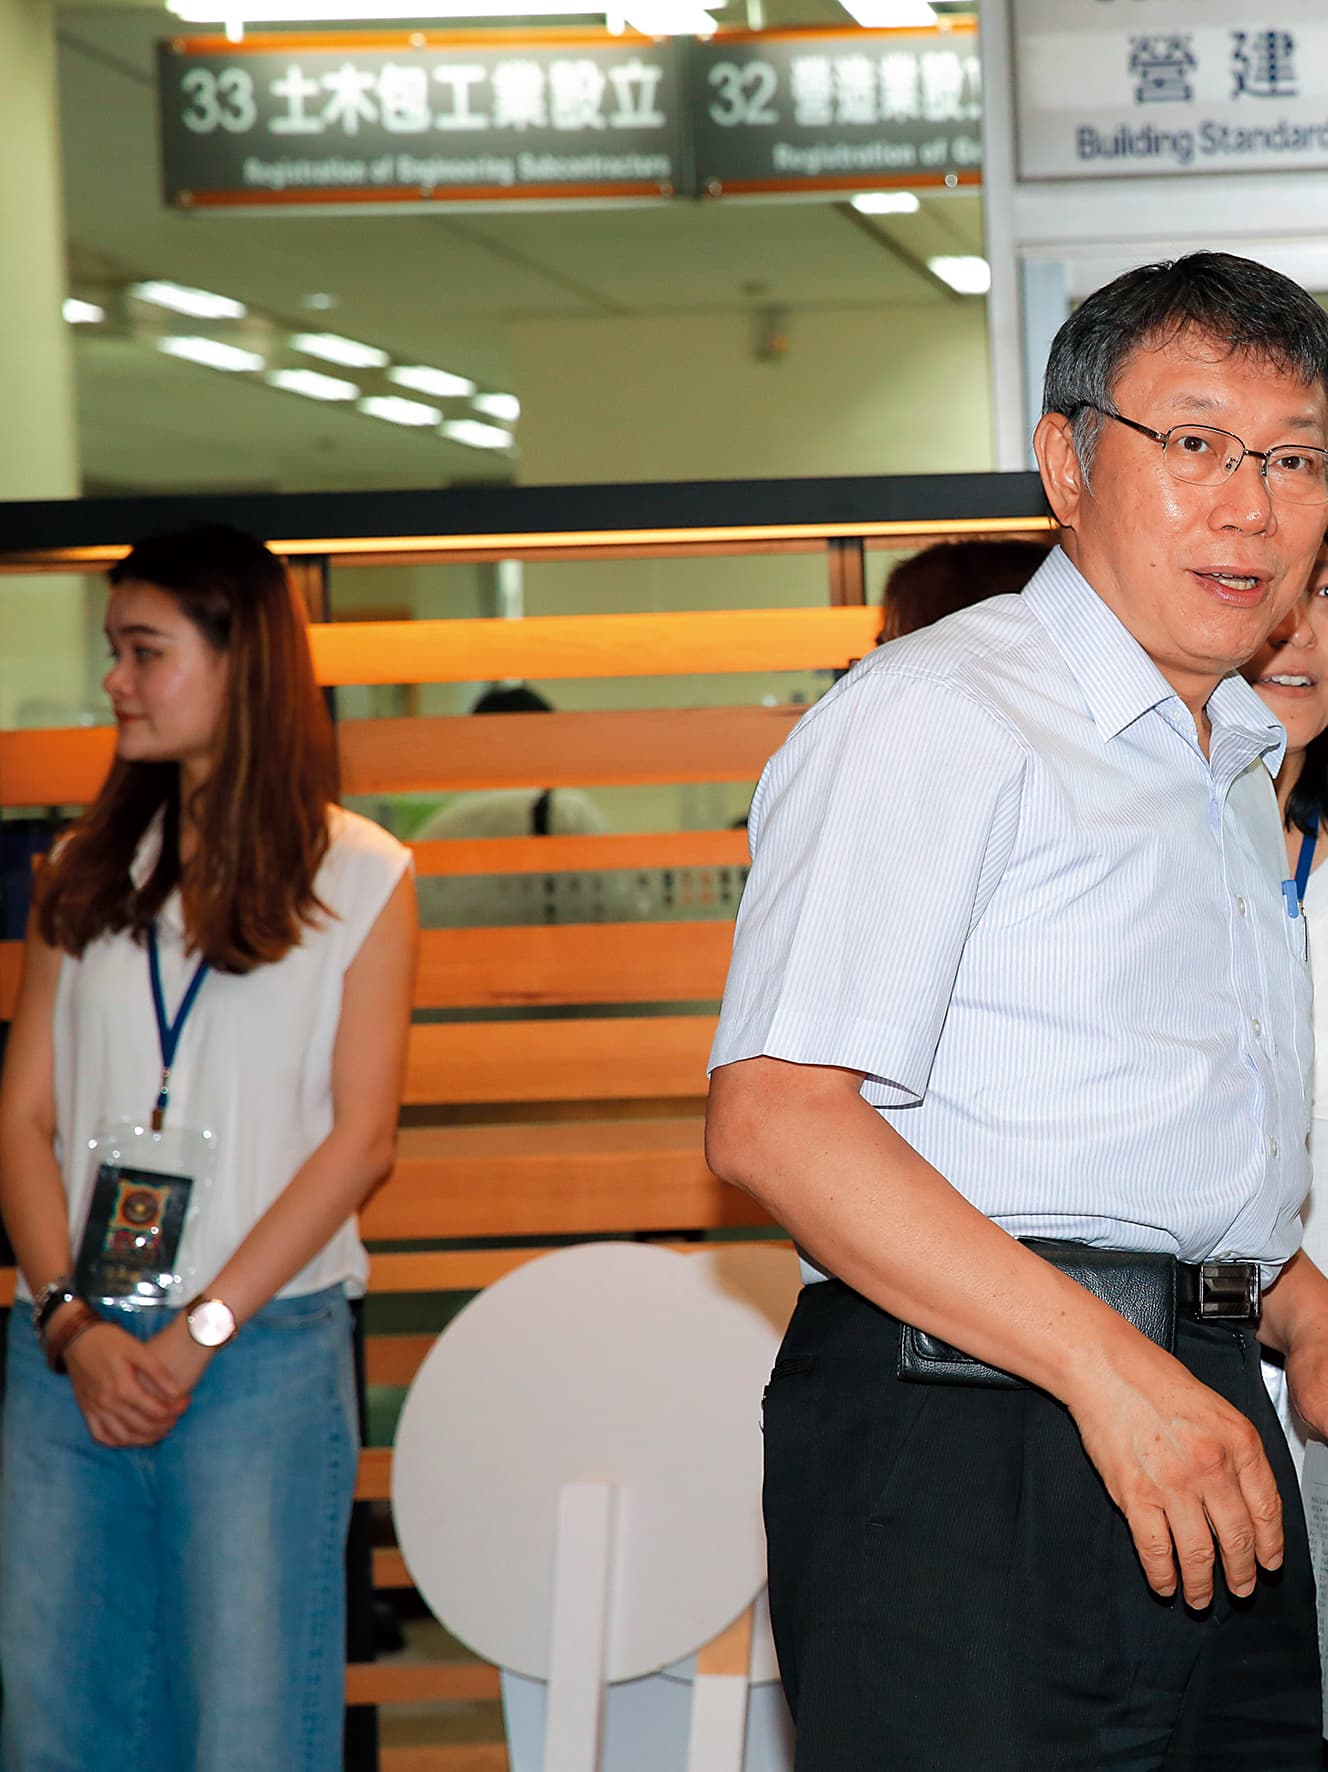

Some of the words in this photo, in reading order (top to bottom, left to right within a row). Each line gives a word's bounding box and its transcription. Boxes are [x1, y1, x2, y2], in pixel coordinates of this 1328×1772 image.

[181, 67, 257, 134] 33
[267, 57, 668, 136] 土木包工業設立
[707, 61, 780, 127] 32
[772, 142, 917, 175] Registration
[919, 136, 948, 167] of
[1076, 123, 1194, 164] Building
